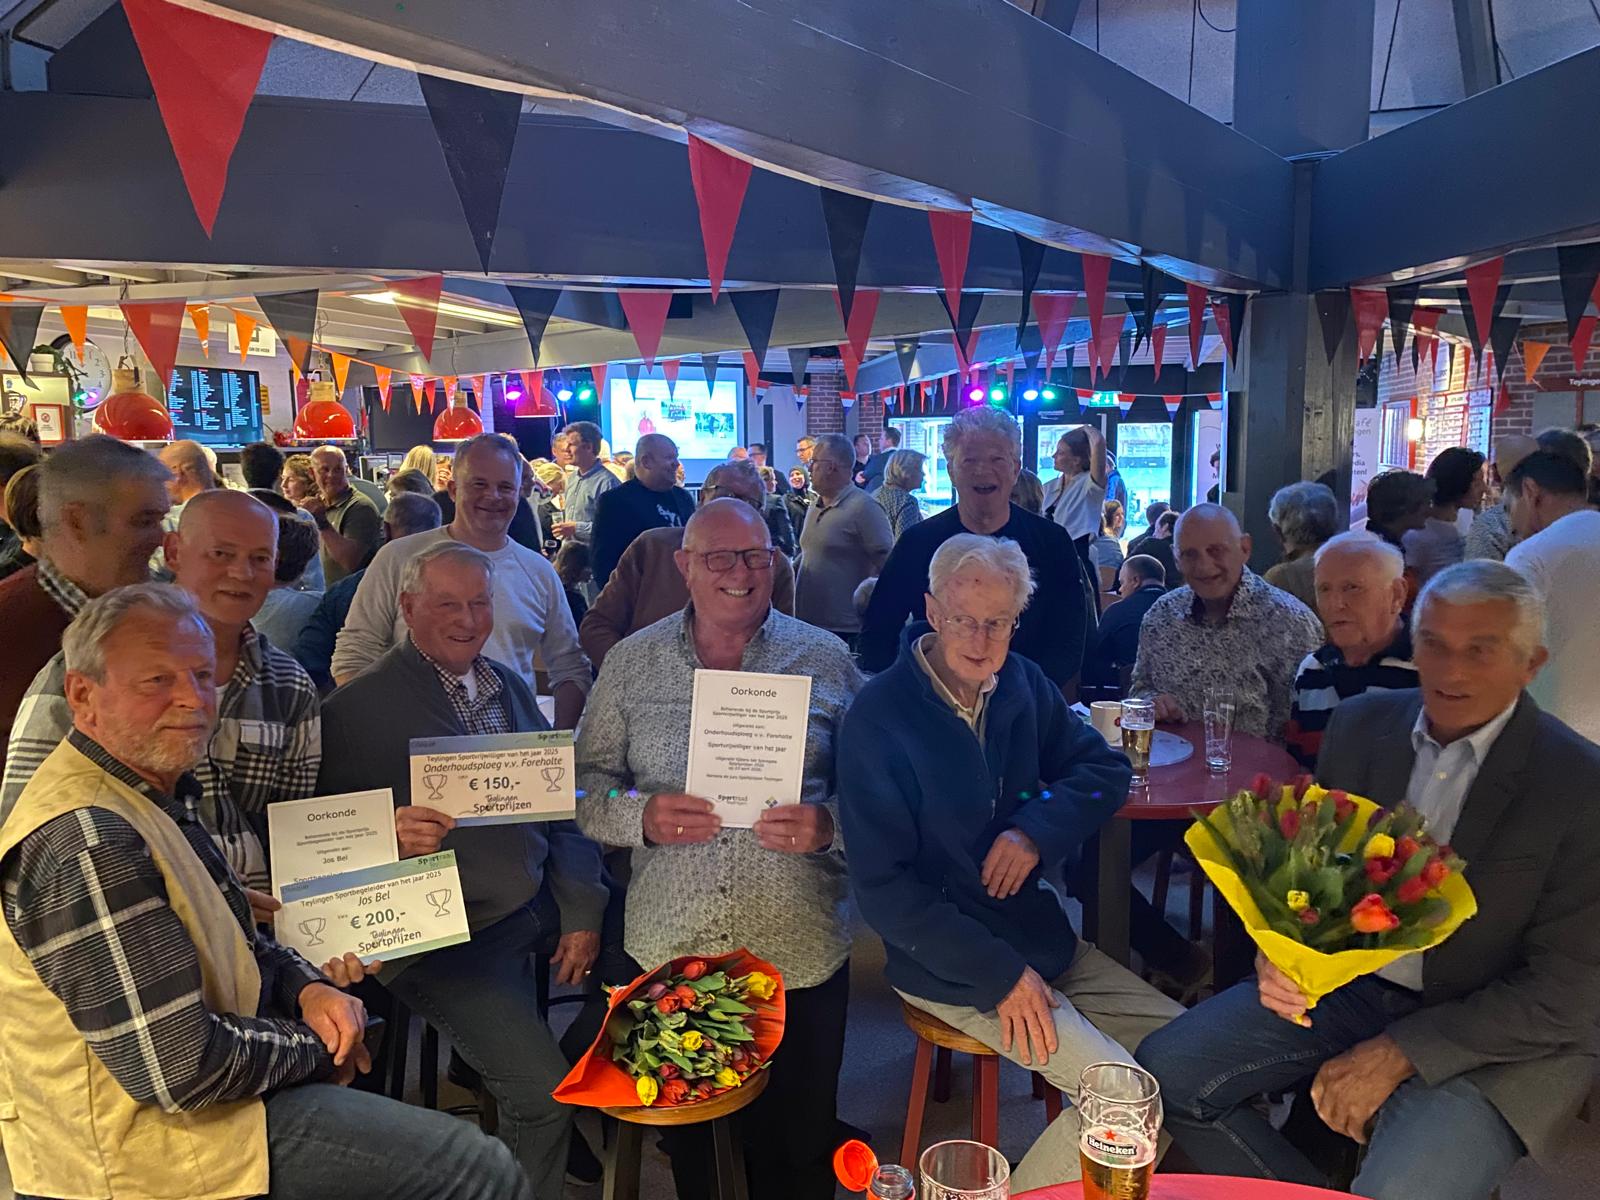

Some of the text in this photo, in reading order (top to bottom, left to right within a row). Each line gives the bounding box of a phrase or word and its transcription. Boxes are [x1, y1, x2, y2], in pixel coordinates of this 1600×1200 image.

[731, 686, 777, 698] Oorkonde
[424, 762, 502, 773] Onderhoudsploeg
[521, 757, 562, 767] Foreholte
[427, 754, 456, 764] Teylingen
[458, 752, 506, 762] Sportvrijwilliger
[531, 750, 542, 758] jaar
[469, 776, 520, 790] € 150,-
[307, 808, 357, 822] Oorkonde
[473, 801, 532, 814] Sportprijzen
[302, 870, 442, 907] Teylingen Sportbegeleider van het jaar 2025
[357, 891, 391, 907] Jos Bel
[350, 908, 406, 929] € 200,-
[358, 931, 422, 953] Sportprijzen
[1088, 1136, 1136, 1155] Heineken
